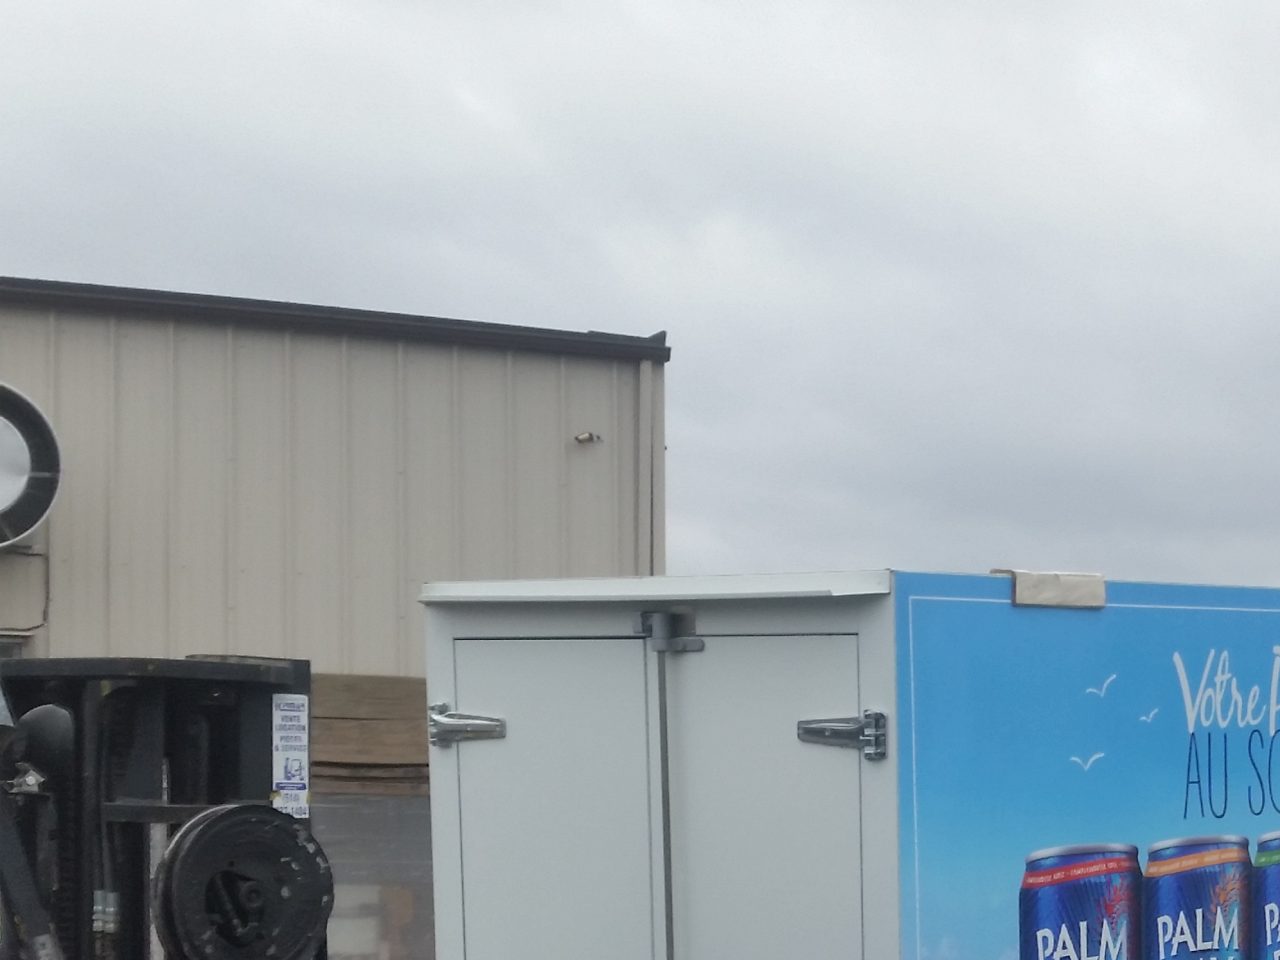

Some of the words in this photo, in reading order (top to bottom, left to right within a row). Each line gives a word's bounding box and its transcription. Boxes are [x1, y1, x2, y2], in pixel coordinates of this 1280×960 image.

[1173, 648, 1267, 735] Votre
[1184, 732, 1228, 820] AU
[1157, 905, 1239, 960] PALM
